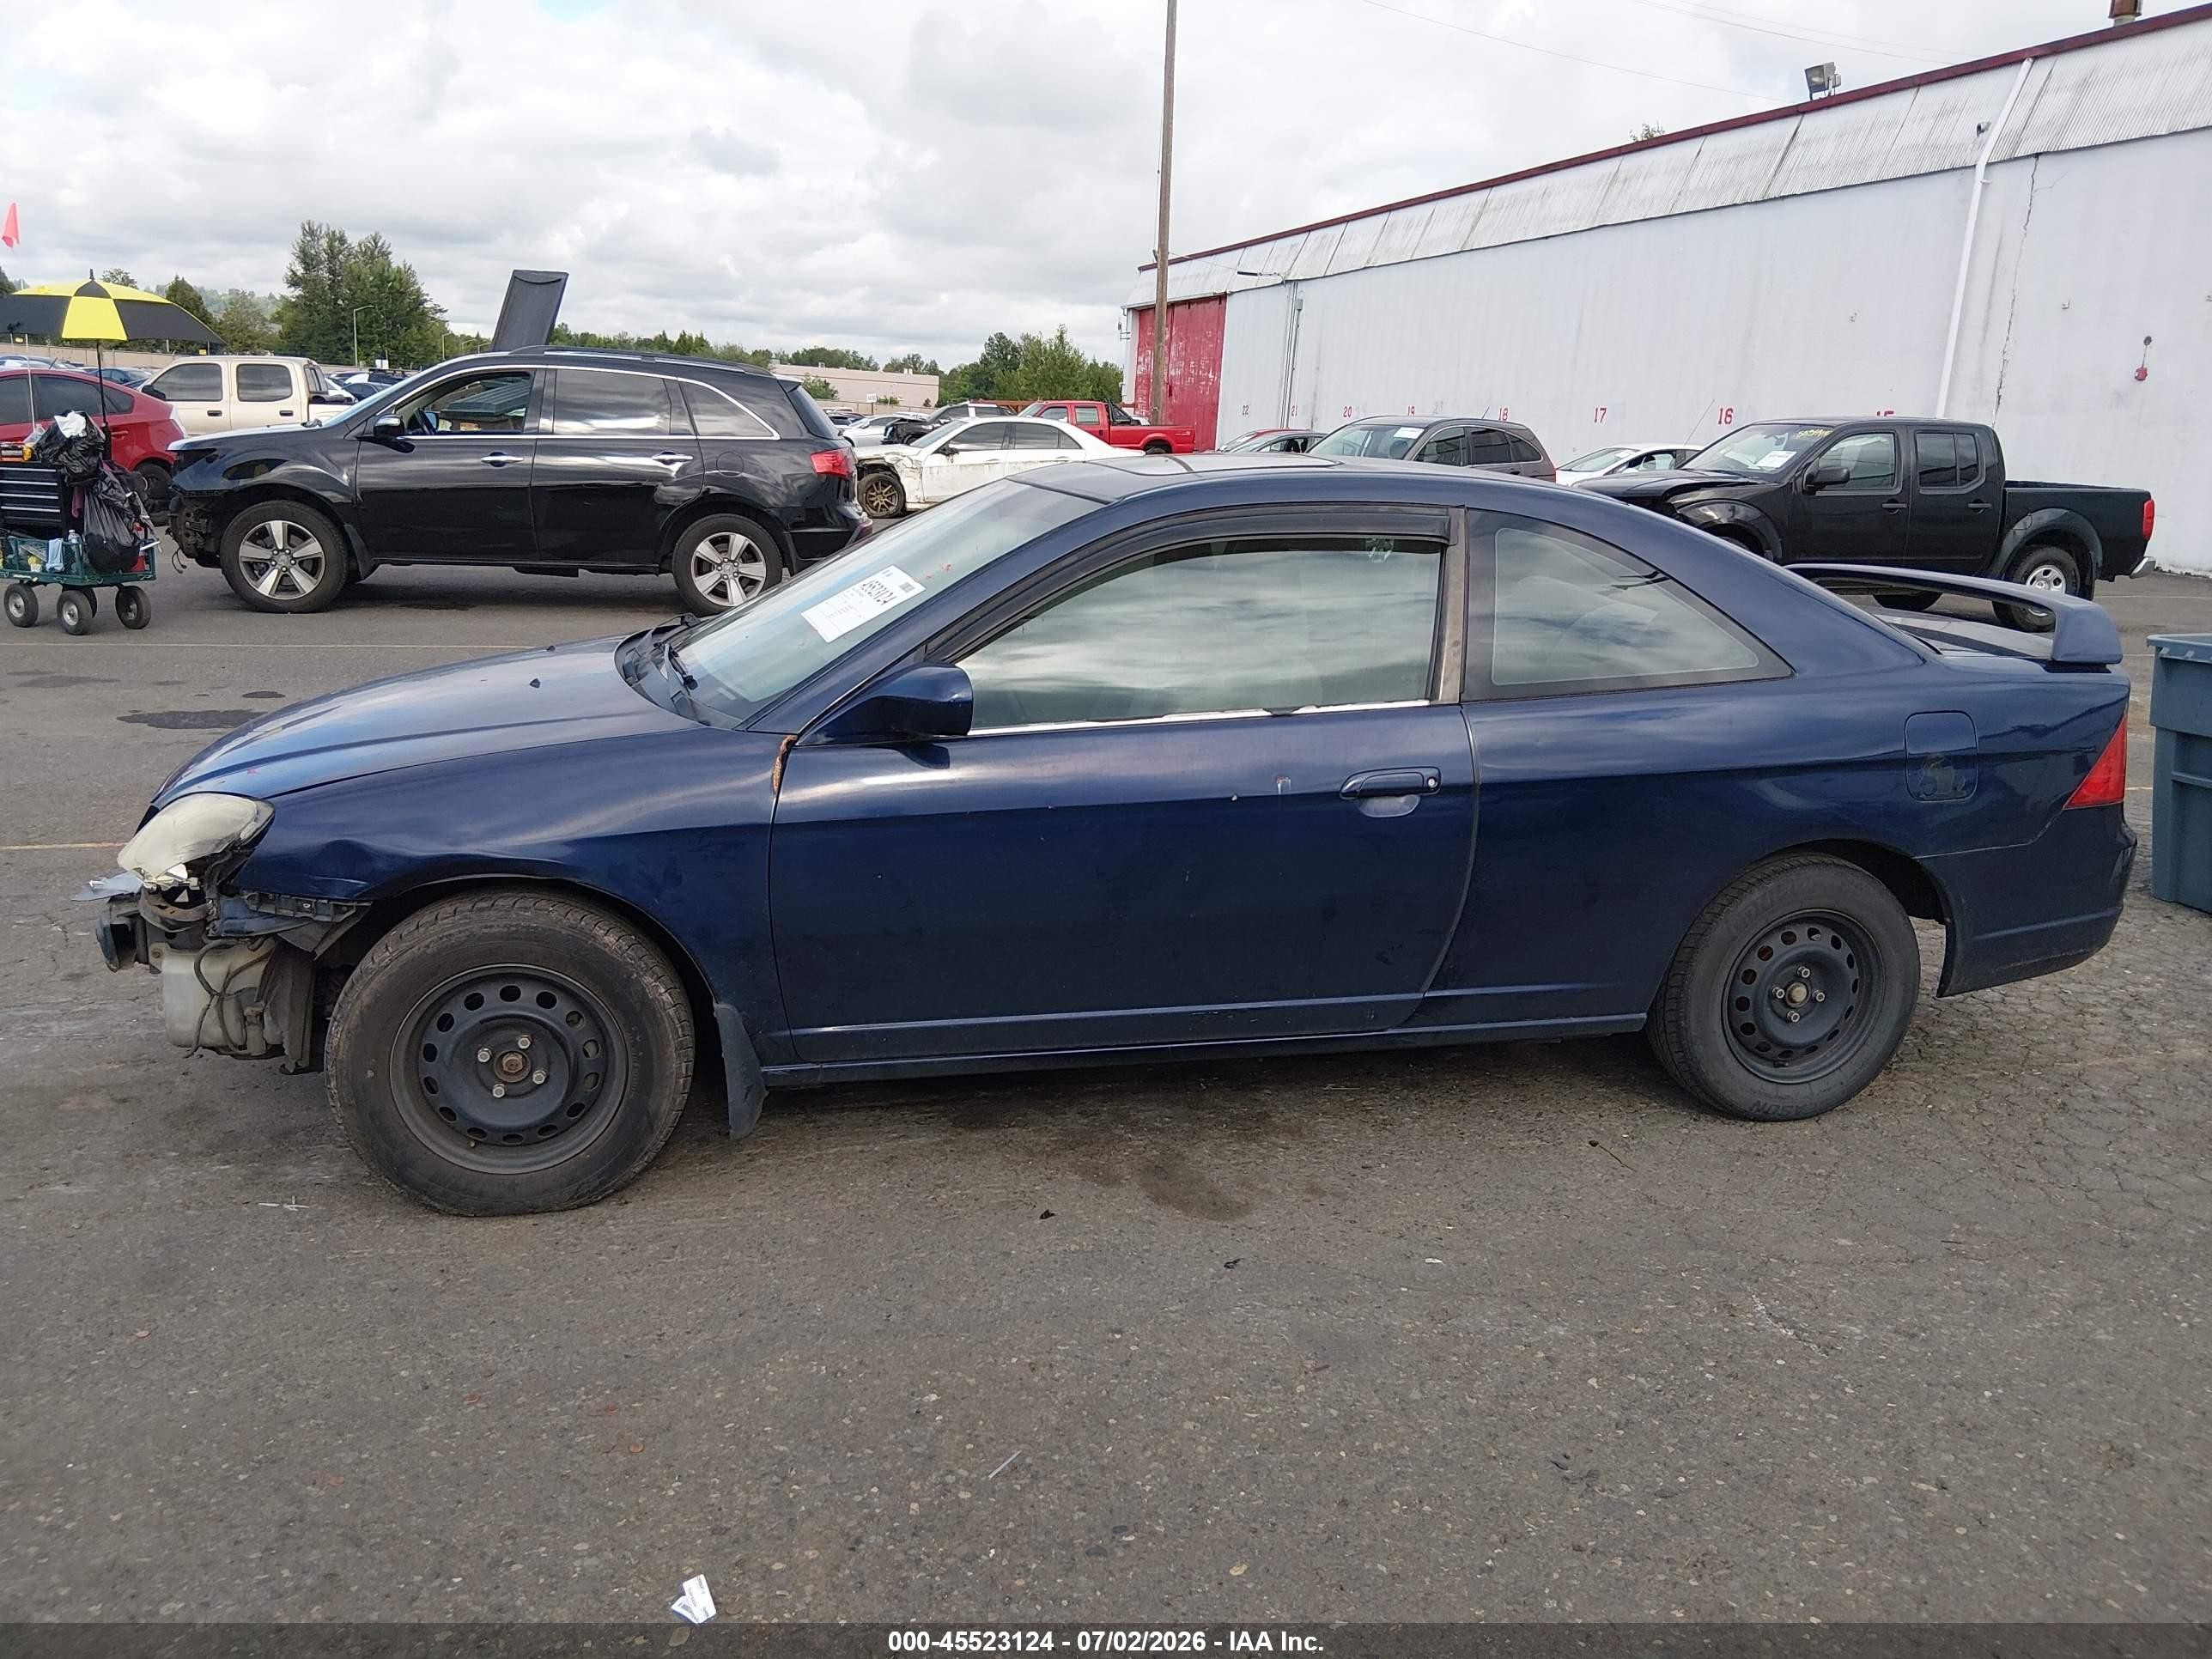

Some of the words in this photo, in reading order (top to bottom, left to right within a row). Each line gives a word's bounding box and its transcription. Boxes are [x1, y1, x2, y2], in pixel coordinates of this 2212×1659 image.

[1242, 404, 1249, 416] 22
[1291, 404, 1298, 416] 21
[1342, 405, 1352, 418] 20
[1407, 405, 1415, 416] 19
[1498, 407, 1509, 421] 18
[1594, 407, 1607, 423] 17
[1718, 408, 1734, 424] 16
